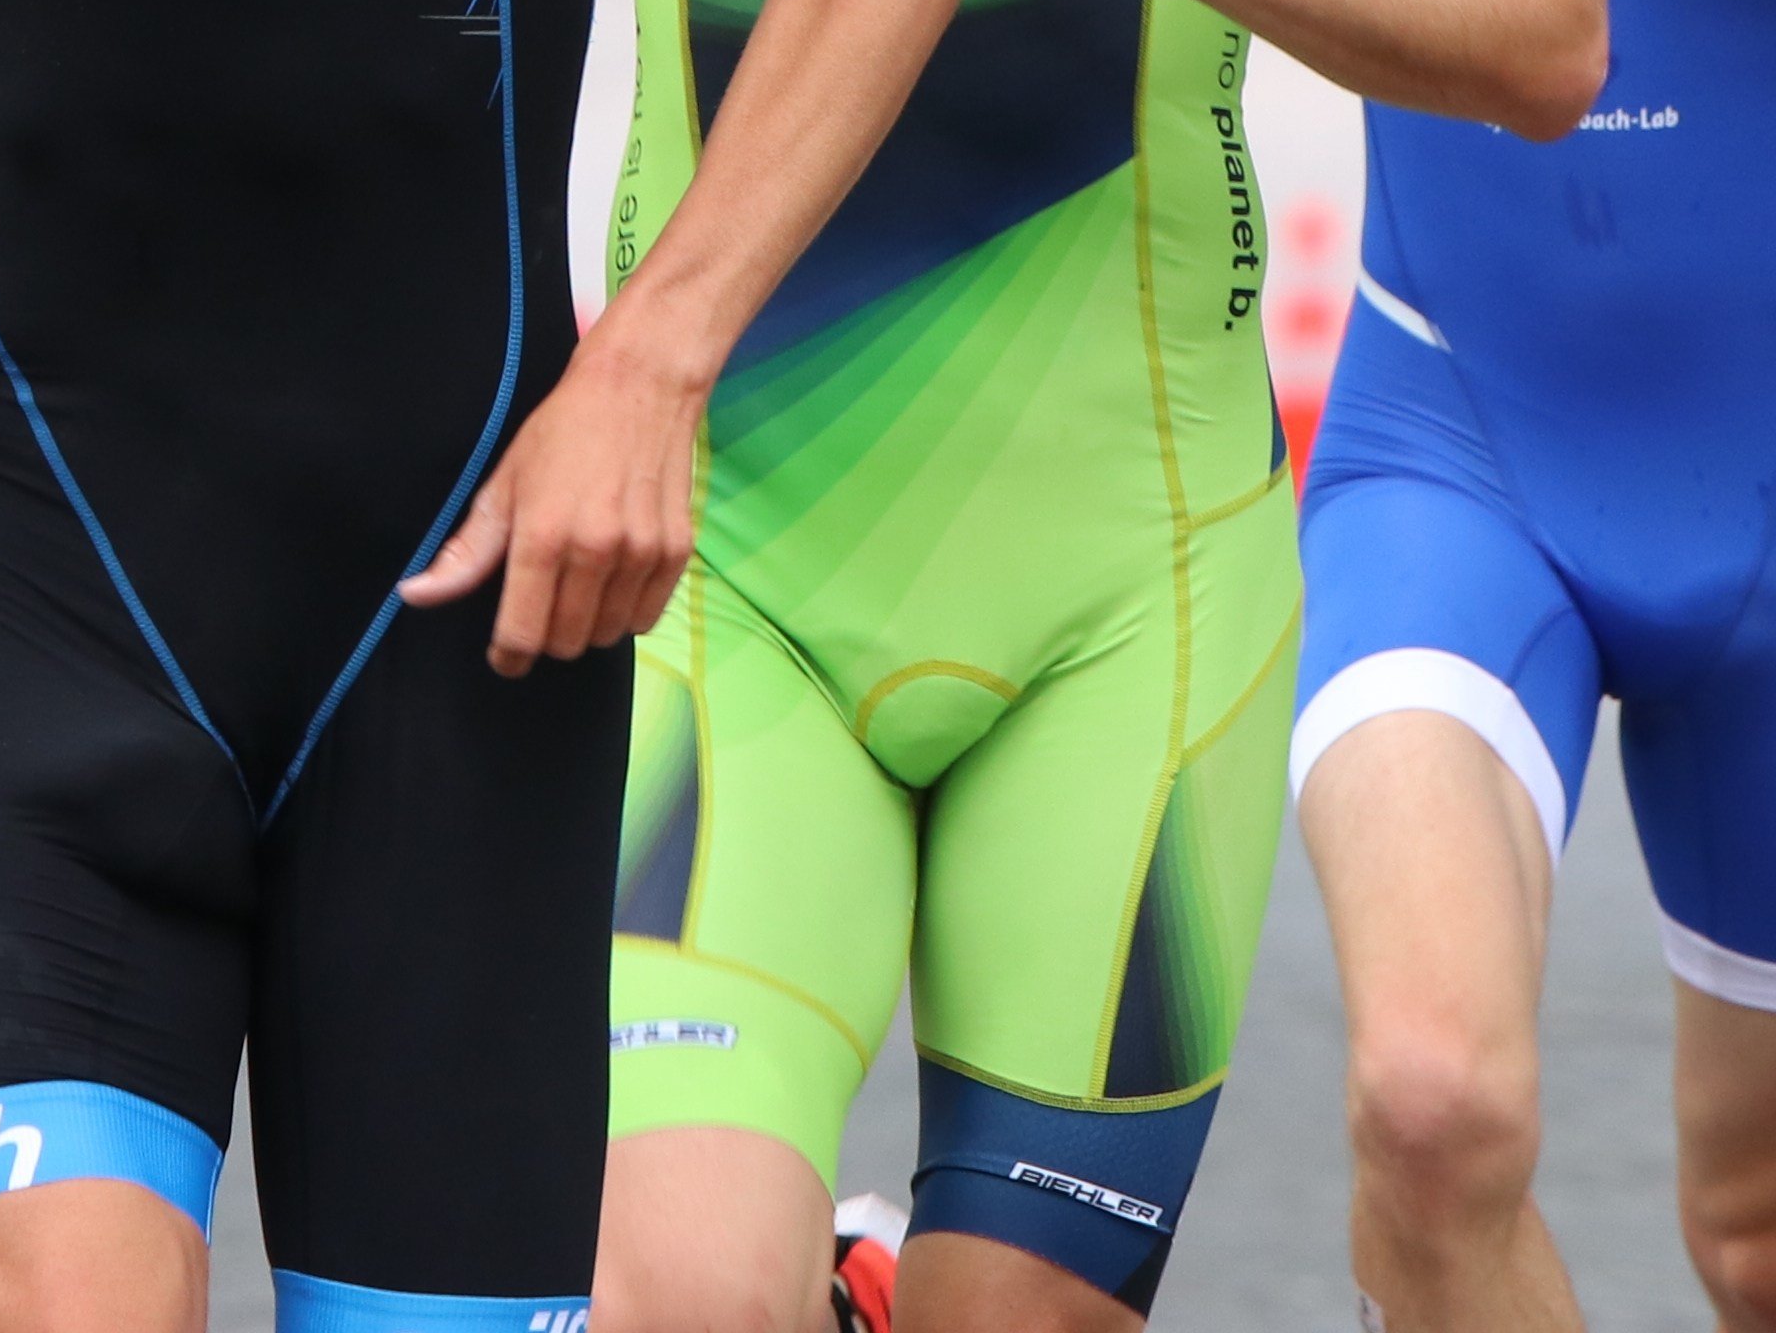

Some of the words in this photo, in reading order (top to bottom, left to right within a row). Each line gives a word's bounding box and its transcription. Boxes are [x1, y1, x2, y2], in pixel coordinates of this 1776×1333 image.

[1218, 31, 1240, 90] no
[1210, 106, 1259, 272] planet
[1225, 288, 1257, 332] b.
[1022, 1168, 1157, 1222] BIEHLER
